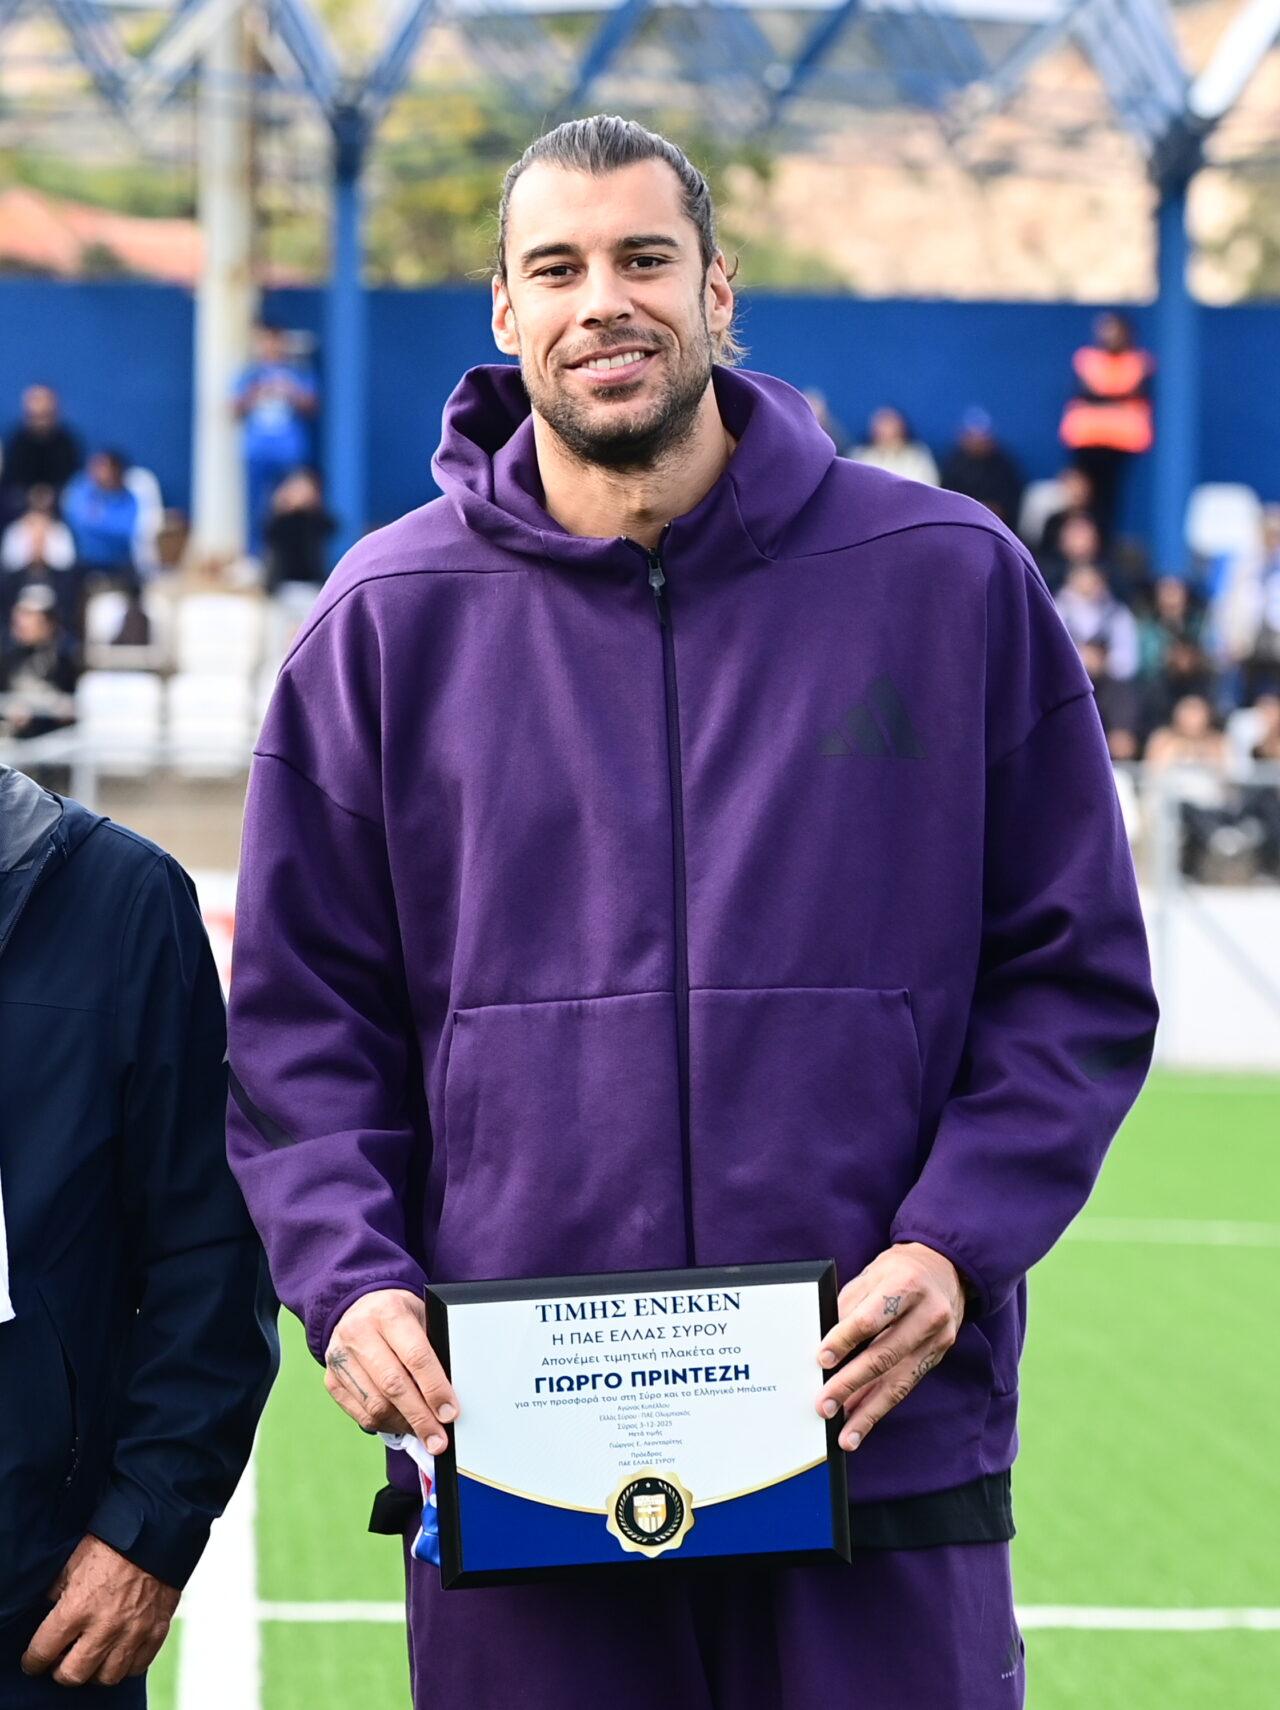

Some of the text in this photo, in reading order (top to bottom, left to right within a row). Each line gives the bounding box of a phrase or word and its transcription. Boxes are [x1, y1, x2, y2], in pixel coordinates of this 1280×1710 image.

[535, 1292, 742, 1323] ΤΙΜΗΣ ΕΝΕΚΕΝ
[552, 1322, 728, 1346] Η ΠΑΕ ΕΛΛΑΣ ΣΥΡΟΥ
[541, 1344, 741, 1367] Απονέμει τιμητική πλακέτα στο
[535, 1364, 750, 1393] ΓΙΩΡΓΟ ΠΡΙΝΤΕΖΗ
[514, 1401, 529, 1409] για
[531, 1400, 547, 1408] την
[550, 1394, 599, 1406] προσφορά
[620, 1393, 637, 1402] στη
[639, 1390, 661, 1400] Σύρο
[694, 1387, 734, 1397] Ελληνικό
[737, 1384, 777, 1394] Μπάσκετ
